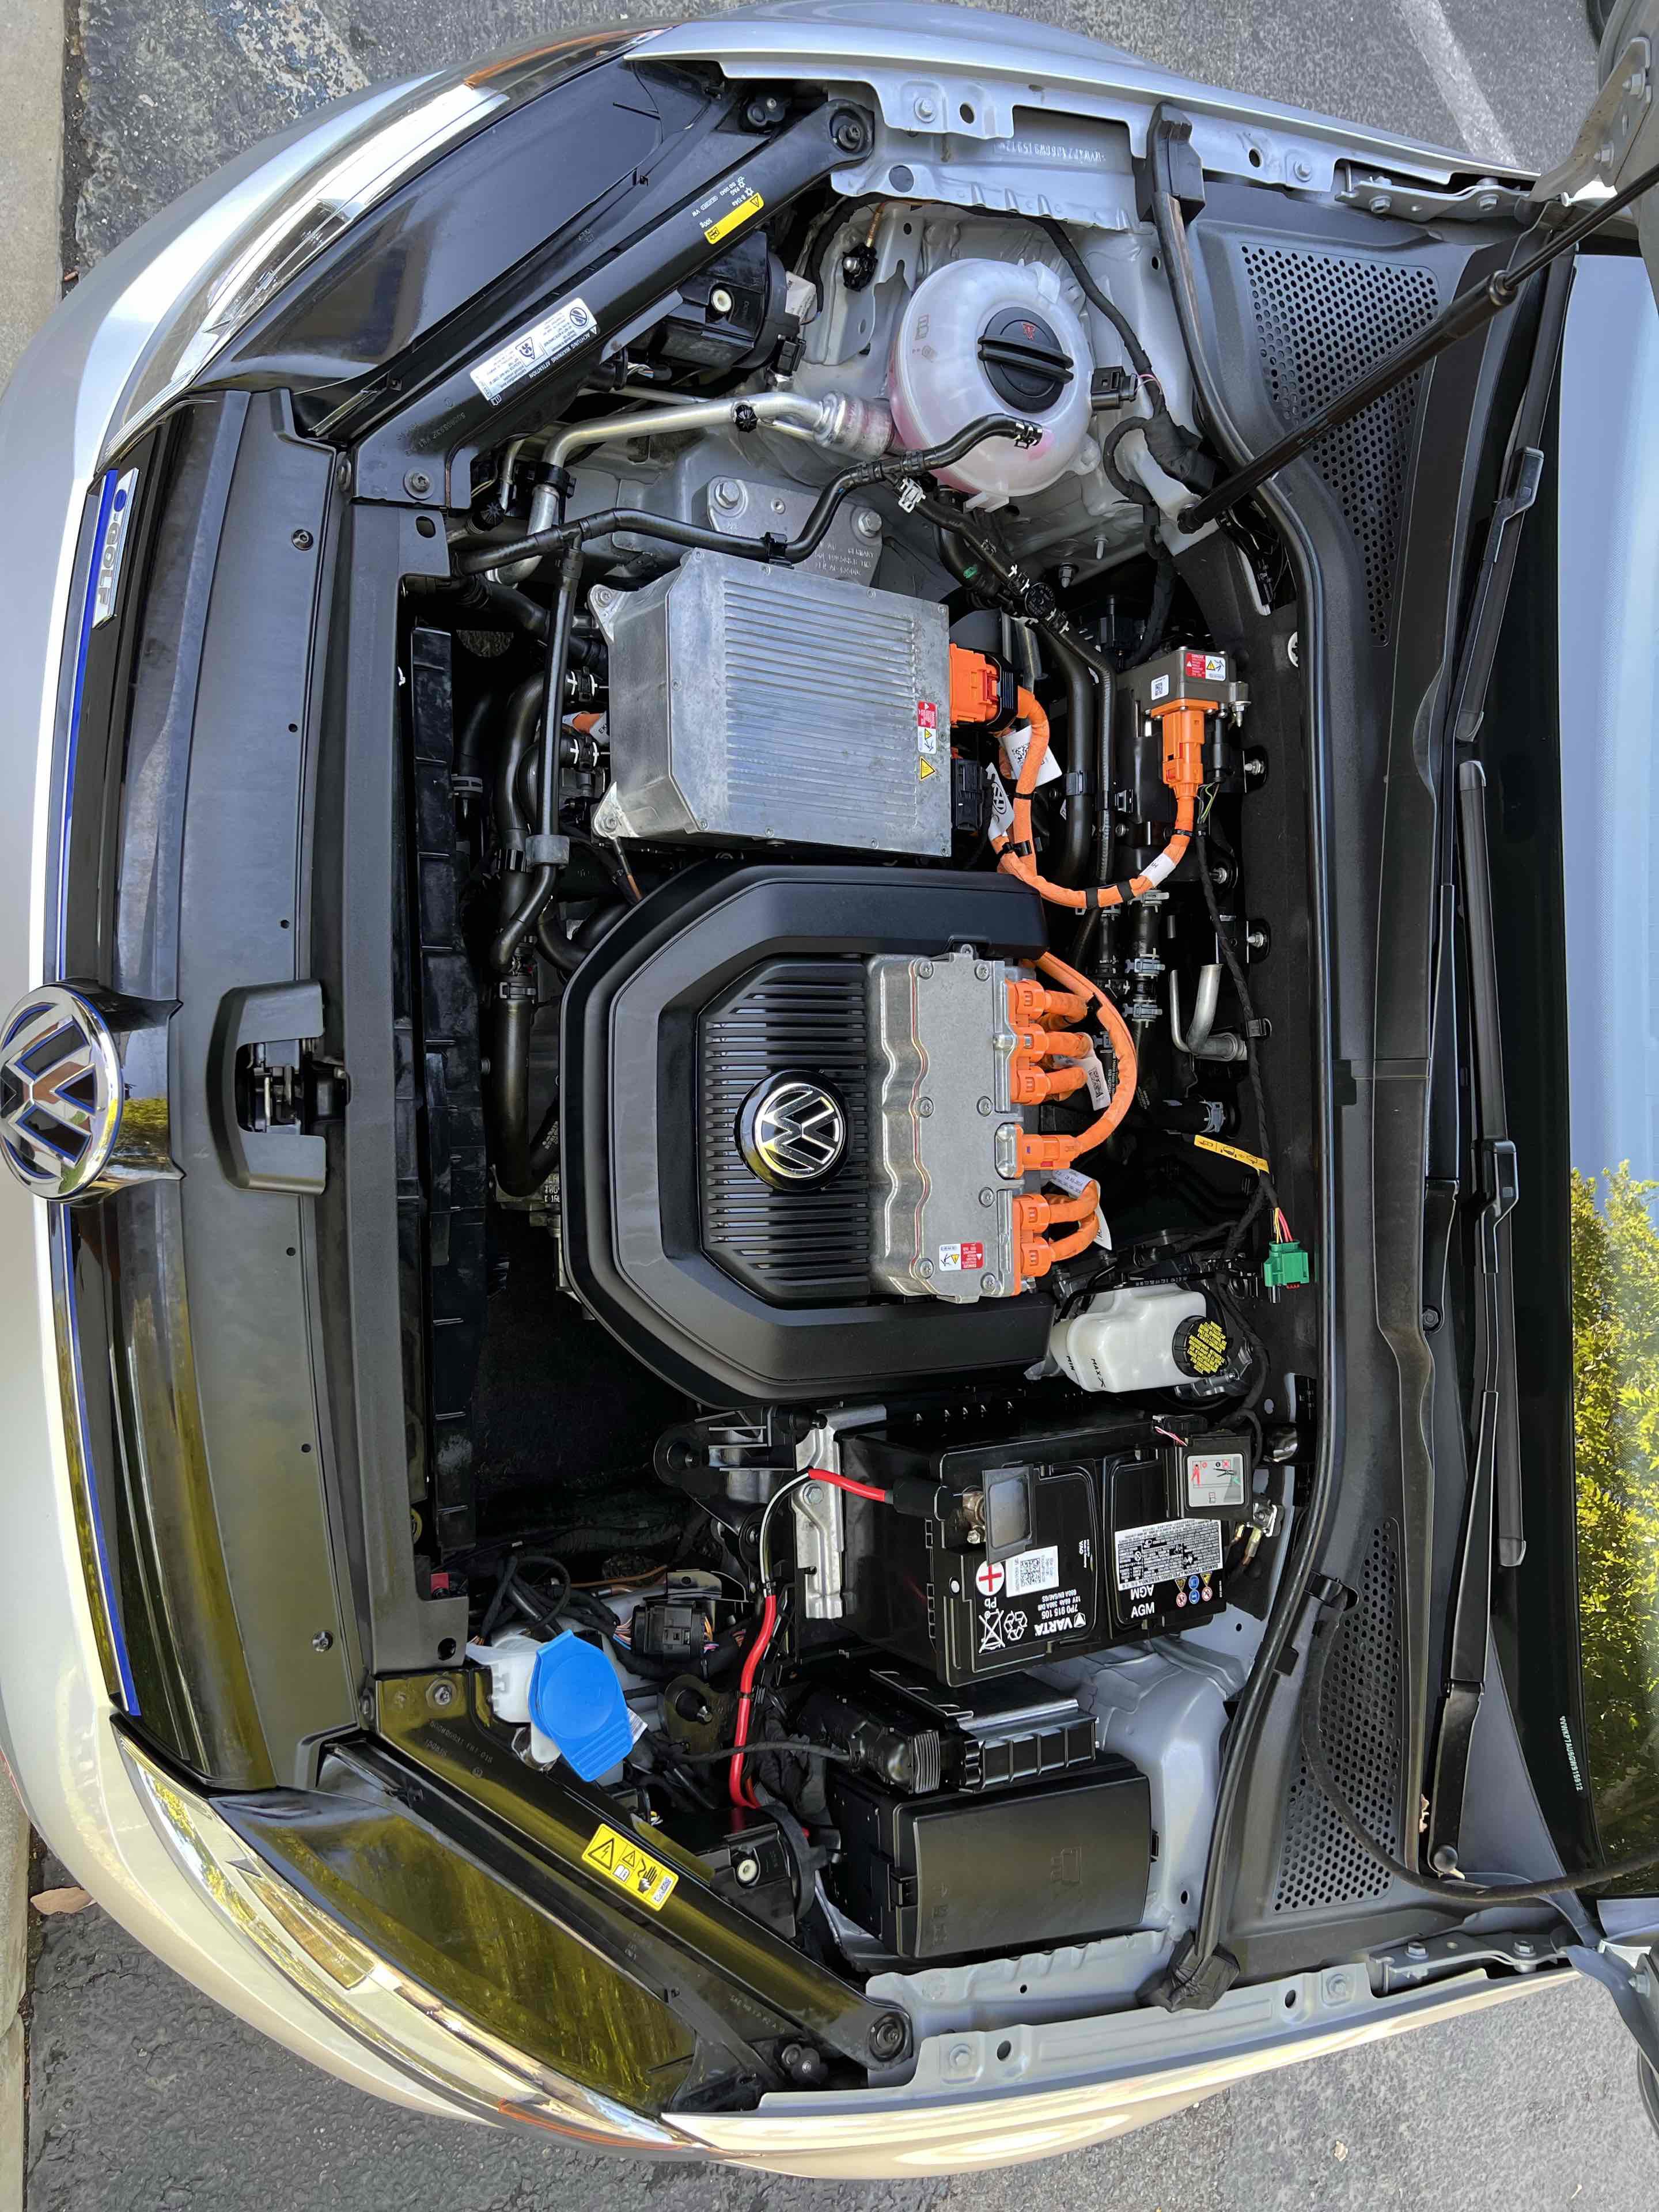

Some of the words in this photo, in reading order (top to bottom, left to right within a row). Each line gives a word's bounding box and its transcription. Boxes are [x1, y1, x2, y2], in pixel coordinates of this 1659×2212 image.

[570, 332, 592, 349] ACHTUNG
[550, 346, 571, 363] WARNING
[528, 360, 551, 379] ATTENTION
[753, 1084, 846, 1178] VW
[1066, 1355, 1075, 1371] MIN
[1090, 1359, 1101, 1376] MAX
[1130, 1584, 1154, 1600] AGM
[984, 1597, 997, 1608] Pb
[1131, 1602, 1154, 1618] AGM
[1041, 1609, 1053, 1619] 105
[1054, 1606, 1066, 1616] 915
[1034, 1617, 1072, 1635] VARTA
